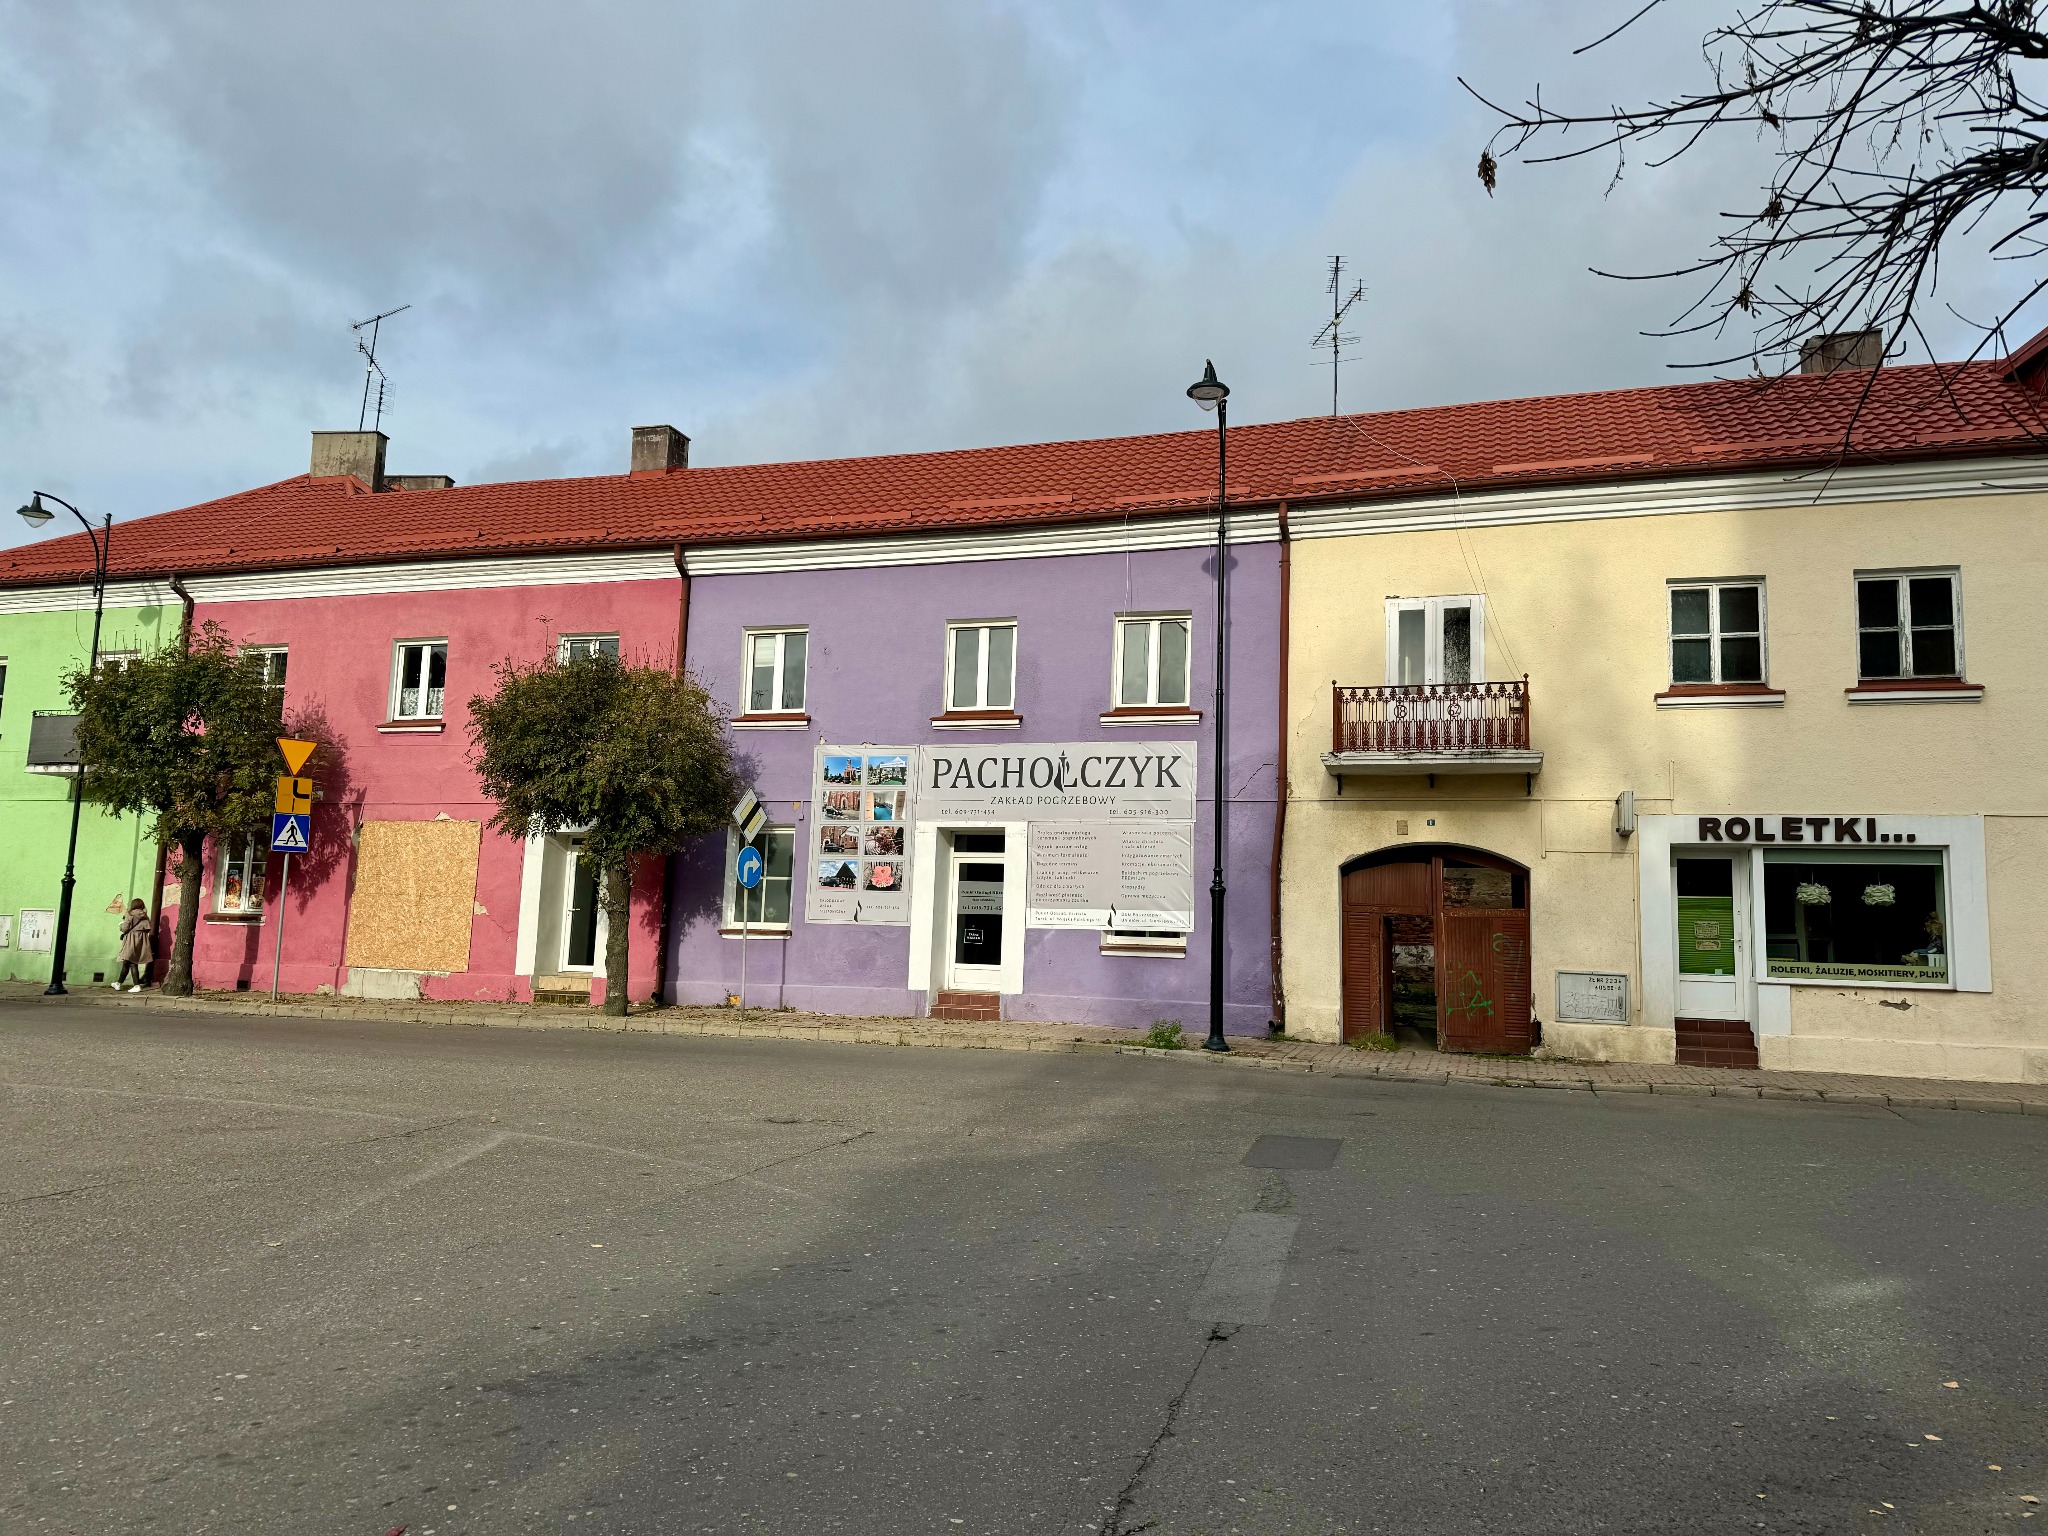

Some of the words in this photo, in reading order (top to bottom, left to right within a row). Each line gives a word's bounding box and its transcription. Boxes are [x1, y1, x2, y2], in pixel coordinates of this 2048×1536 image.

[931, 752, 1182, 791] PACHOŁCZYK
[990, 796, 1033, 804] ZAKŁAD
[1038, 796, 1116, 805] POGRZEBOWY
[1770, 965, 1813, 975] ROLETKI,
[1815, 965, 1857, 977] ŻALUZJE,
[1858, 968, 1918, 979] MOSKITIERY,
[1919, 970, 1946, 979] PLISY
